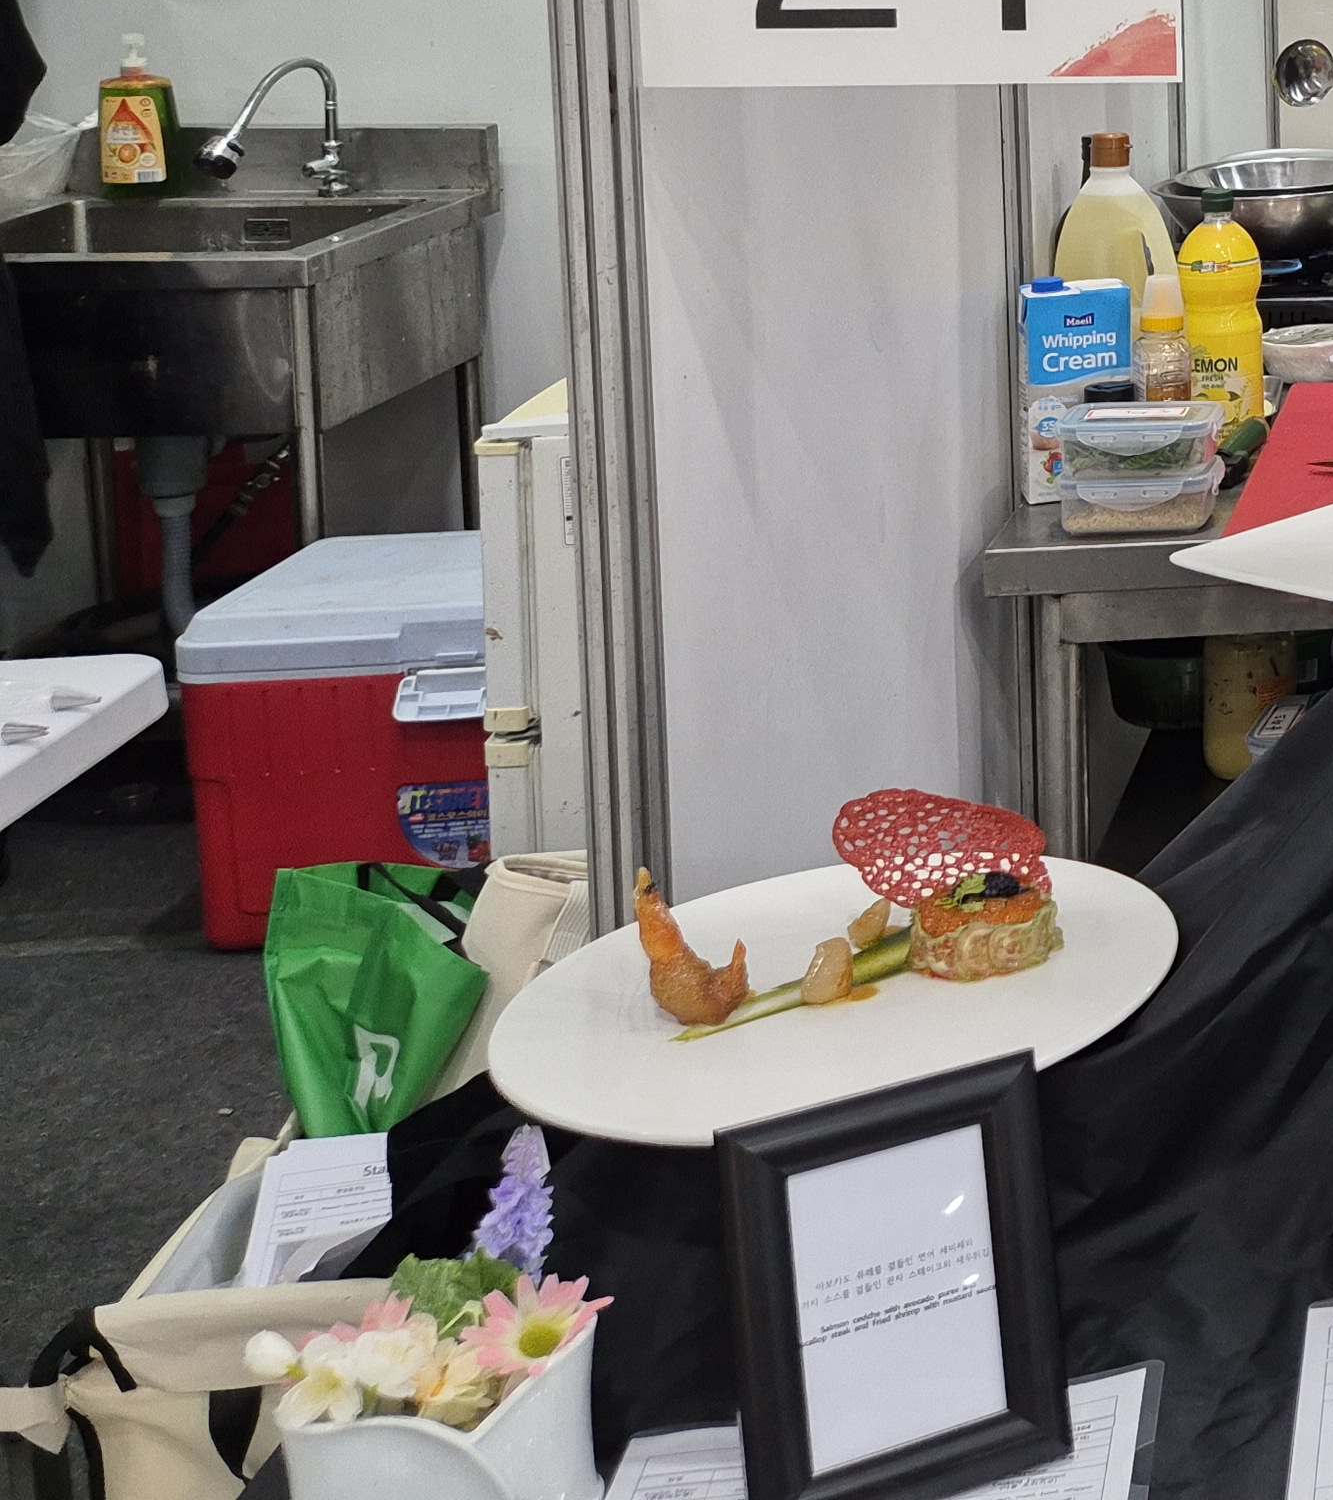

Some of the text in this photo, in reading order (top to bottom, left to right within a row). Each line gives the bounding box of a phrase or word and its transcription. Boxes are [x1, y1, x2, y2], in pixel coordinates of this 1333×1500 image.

[1066, 315, 1092, 327] Maeil
[1042, 331, 1117, 349] Whipping
[1042, 351, 1117, 373] Cream
[1192, 357, 1238, 373] EMON
[363, 1165, 387, 1177] Sta
[820, 1320, 850, 1334] Salmon
[854, 1321, 869, 1332] and
